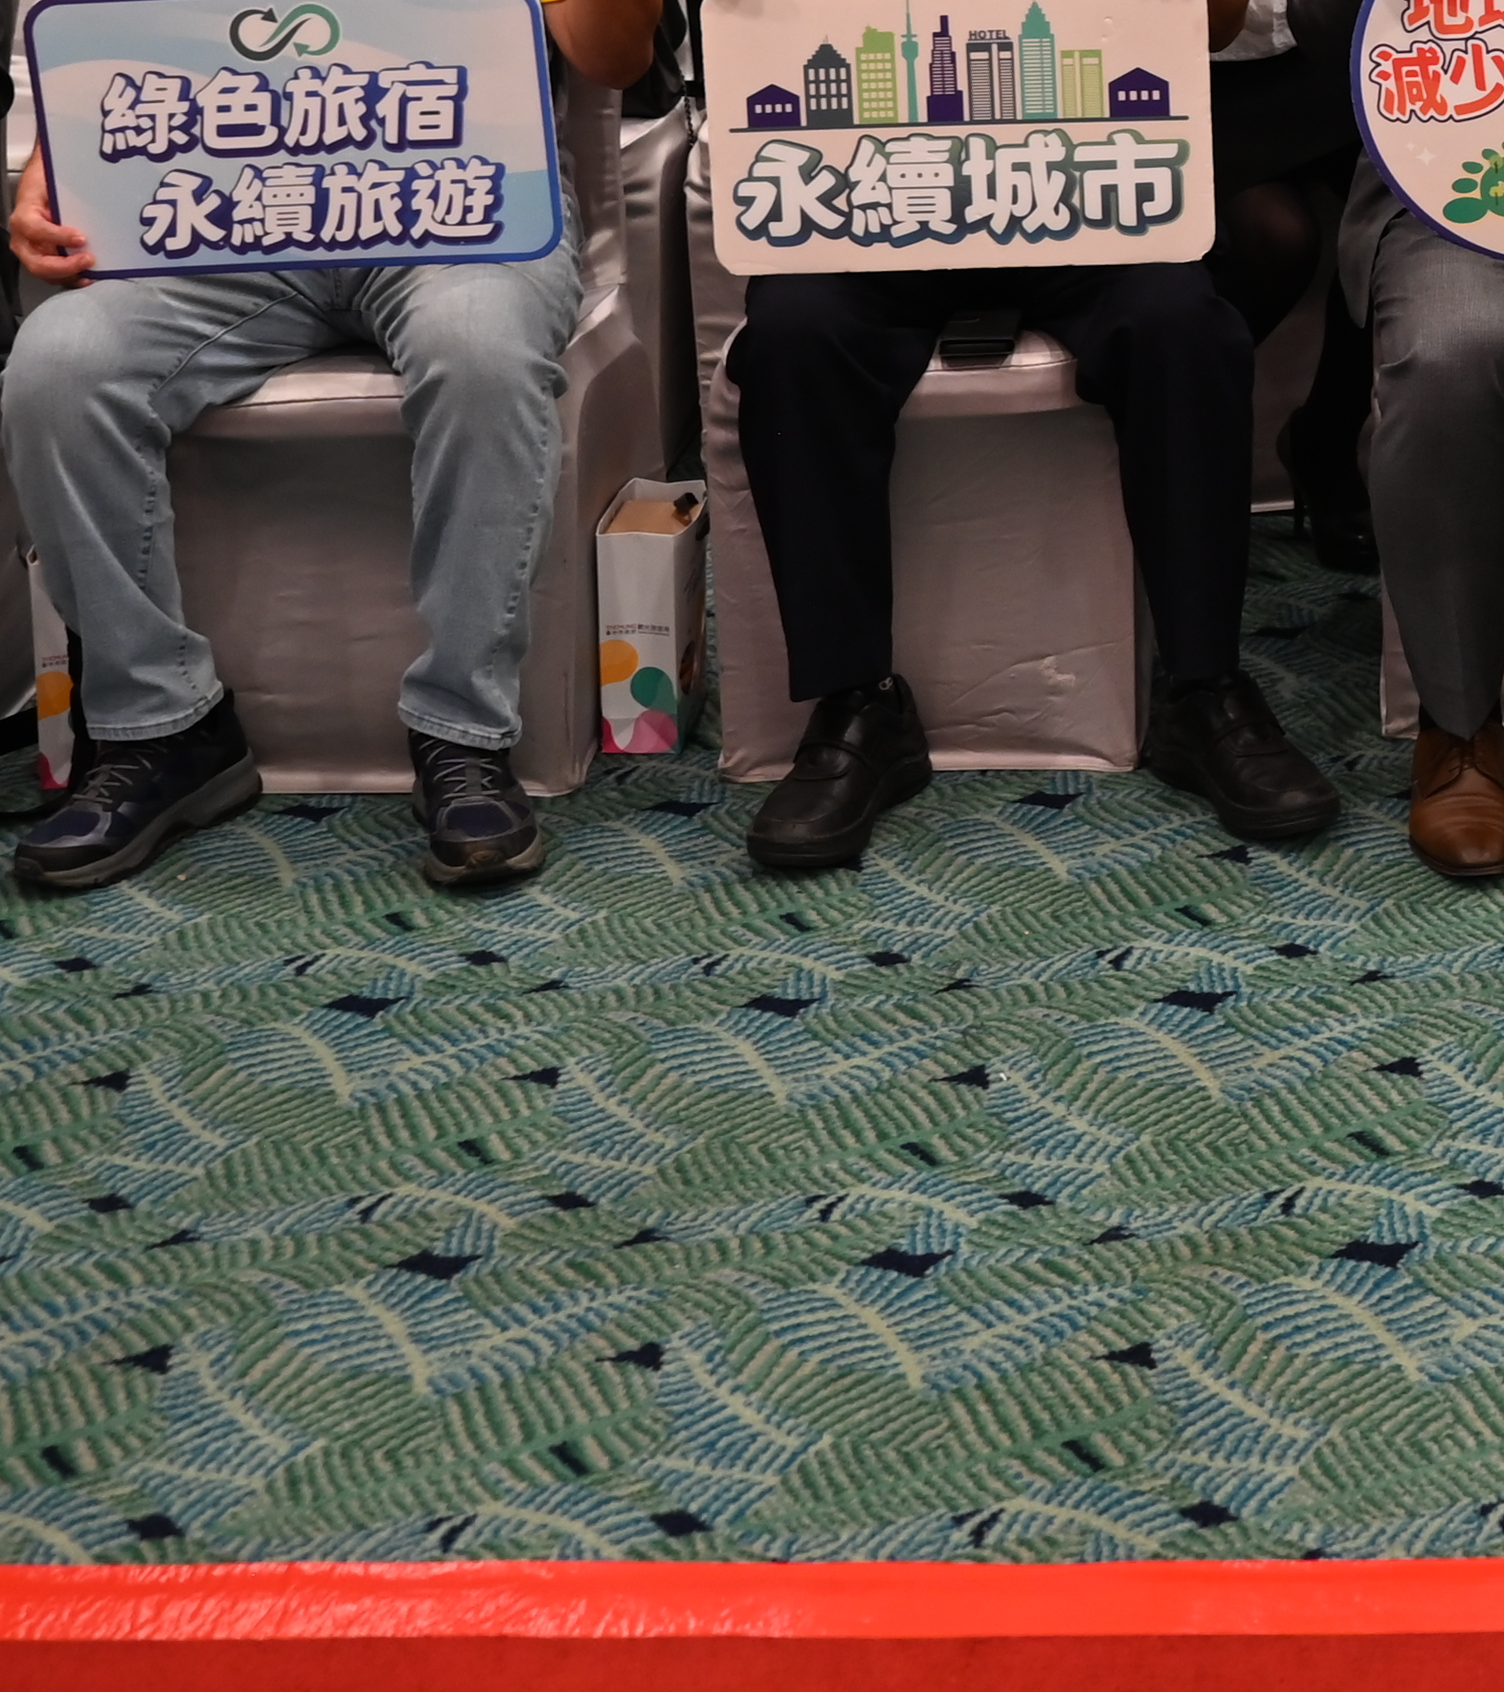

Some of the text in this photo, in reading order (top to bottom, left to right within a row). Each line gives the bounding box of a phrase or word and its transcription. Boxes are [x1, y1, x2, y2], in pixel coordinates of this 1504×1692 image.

[968, 29, 1011, 41] HOTEL
[99, 60, 468, 163] 綠色旅宿
[140, 155, 505, 260] 永續旅遊
[733, 128, 1190, 248] 永續城市
